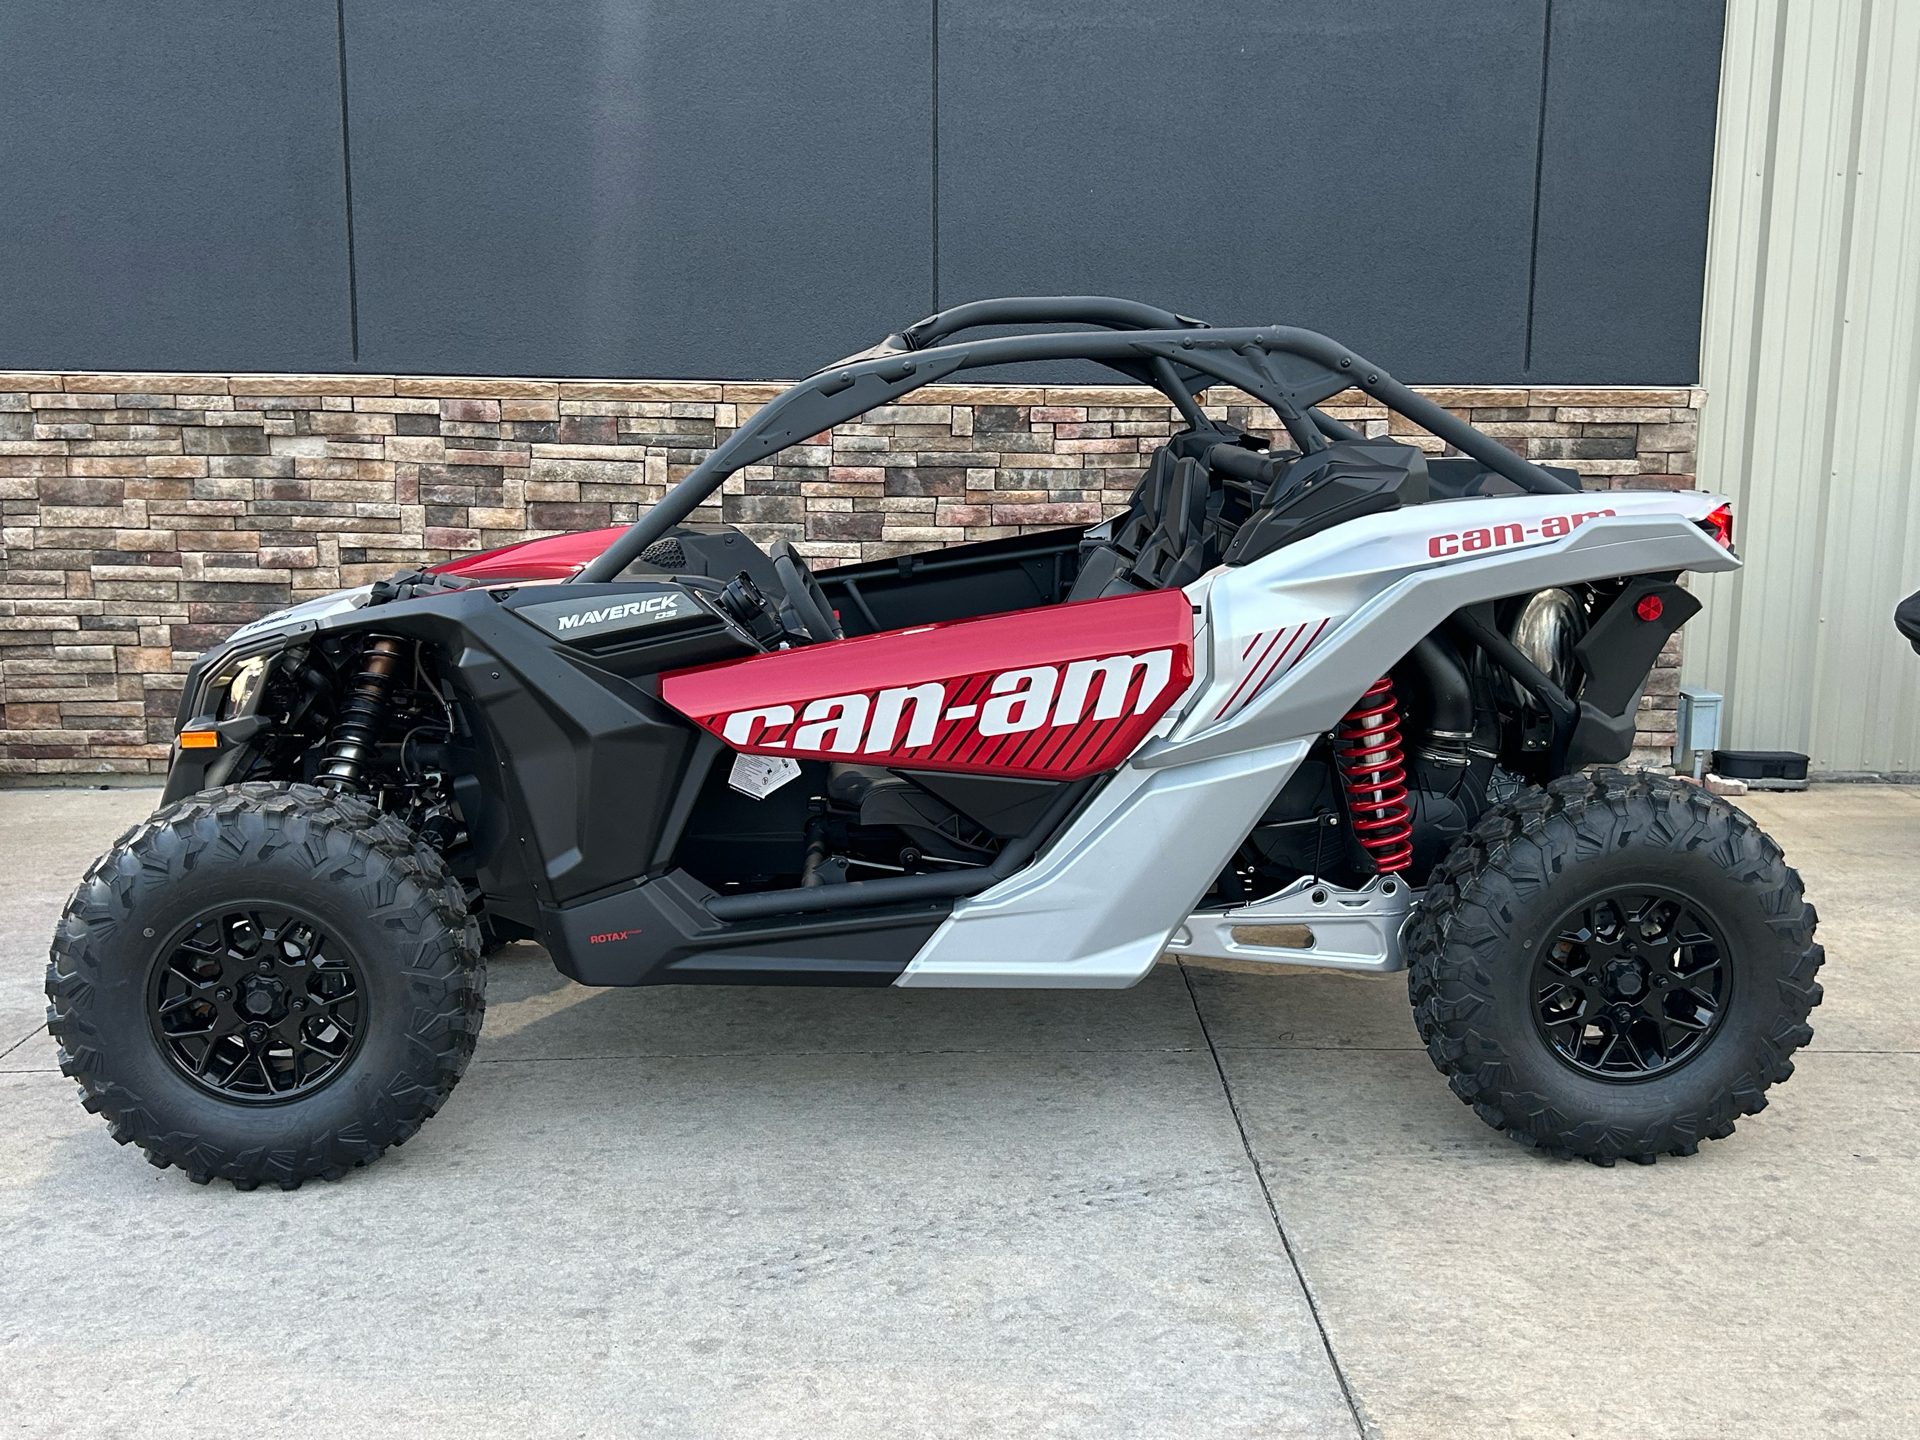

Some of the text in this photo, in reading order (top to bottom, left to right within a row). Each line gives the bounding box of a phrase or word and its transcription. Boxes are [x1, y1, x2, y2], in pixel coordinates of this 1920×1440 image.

[558, 595, 678, 630] MAVERICK
[654, 609, 677, 620] DS
[722, 649, 1173, 754] can-am
[590, 932, 627, 944] ROTAX
